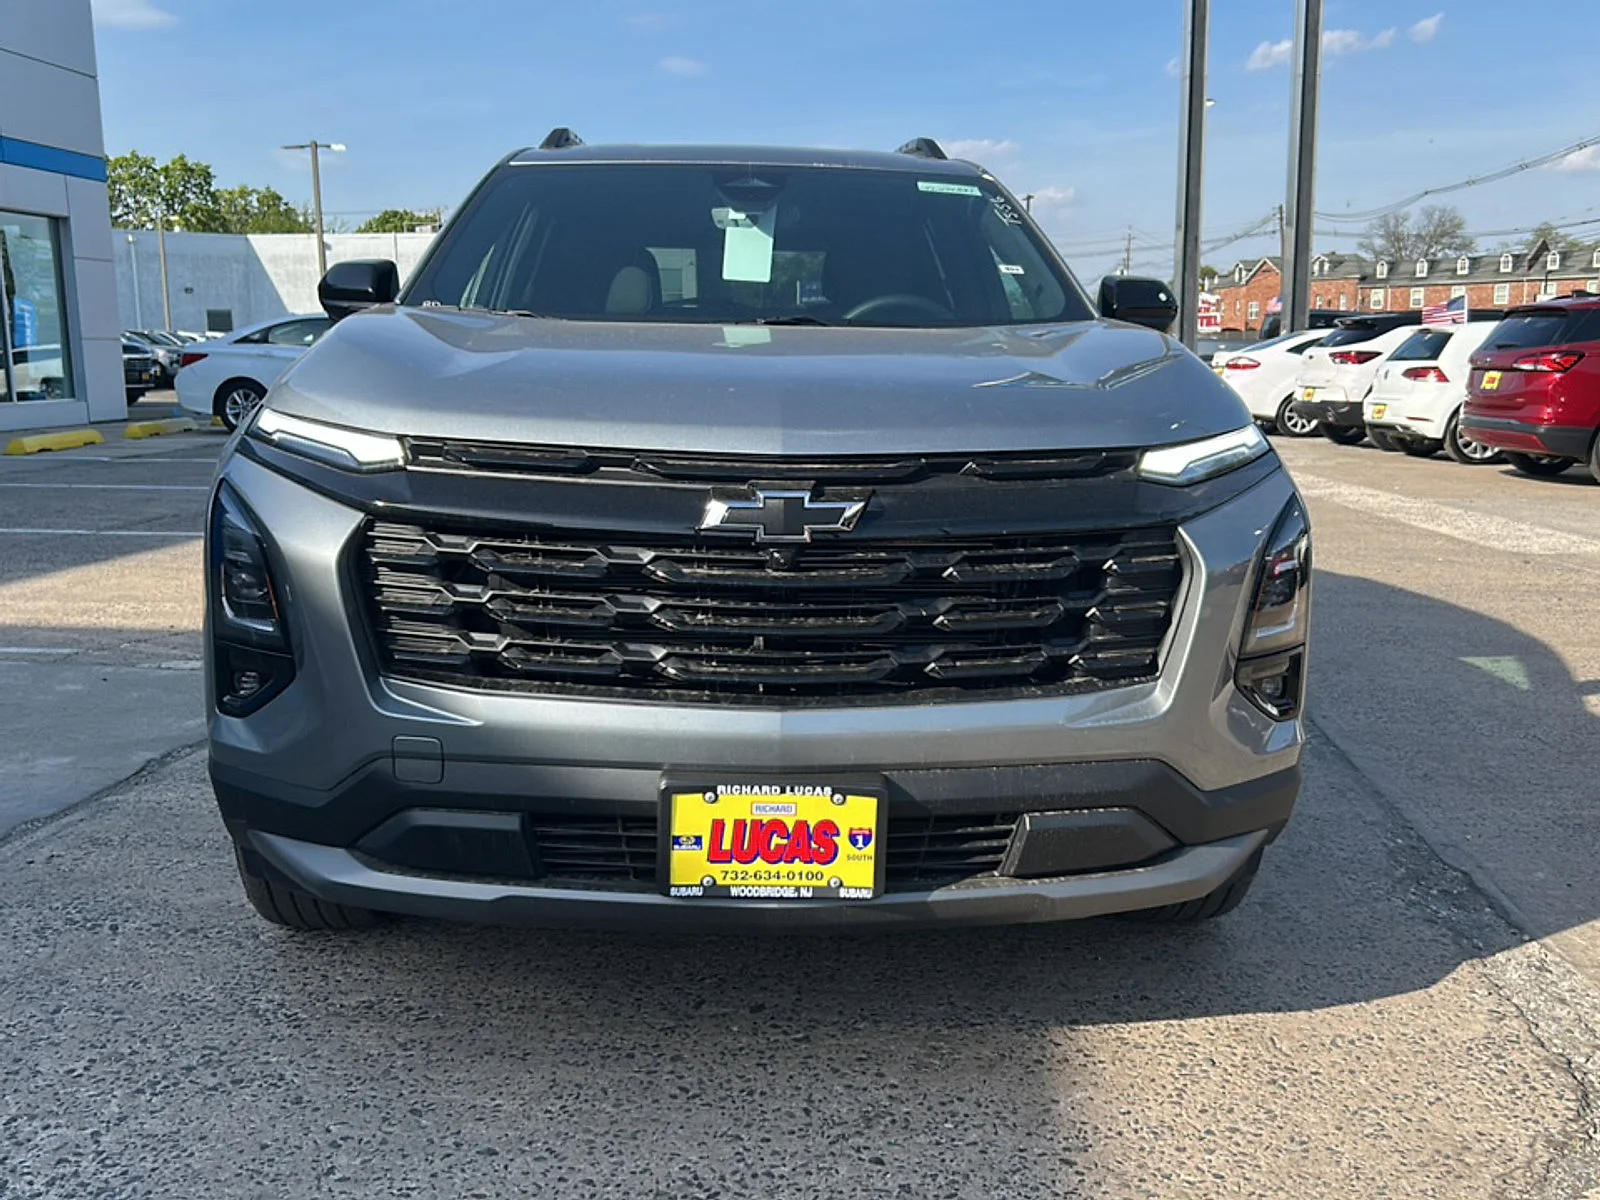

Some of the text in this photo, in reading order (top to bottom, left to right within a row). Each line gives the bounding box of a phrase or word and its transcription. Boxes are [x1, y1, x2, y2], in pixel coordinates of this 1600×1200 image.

[717, 785, 832, 796] RICHARD LUCAS
[755, 804, 792, 813] RICHARD
[707, 818, 840, 865] LUCAS
[855, 834, 864, 848] 1
[721, 870, 824, 881] 732-634-0100
[670, 886, 703, 897] SUBARU
[799, 886, 813, 898] NJ
